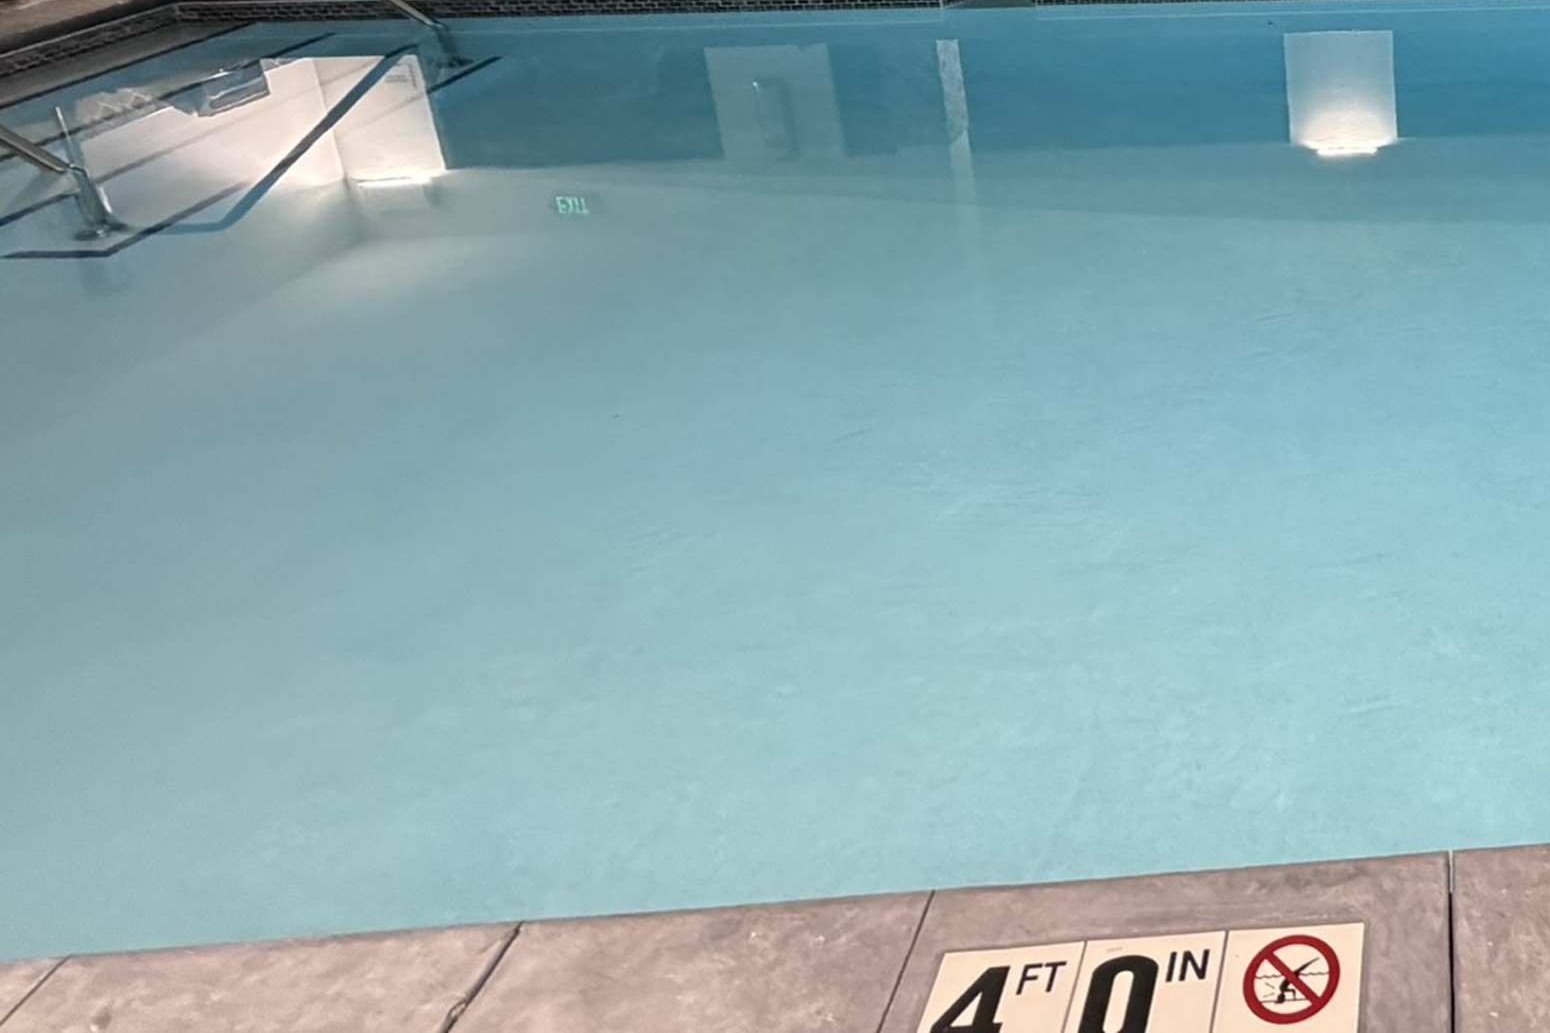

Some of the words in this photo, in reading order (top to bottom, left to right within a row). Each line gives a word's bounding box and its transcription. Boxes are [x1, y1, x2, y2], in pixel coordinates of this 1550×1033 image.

[930, 965, 1011, 1033] 4
[1016, 960, 1067, 995] FT
[1078, 954, 1159, 1033] 0
[1165, 948, 1210, 983] IN
